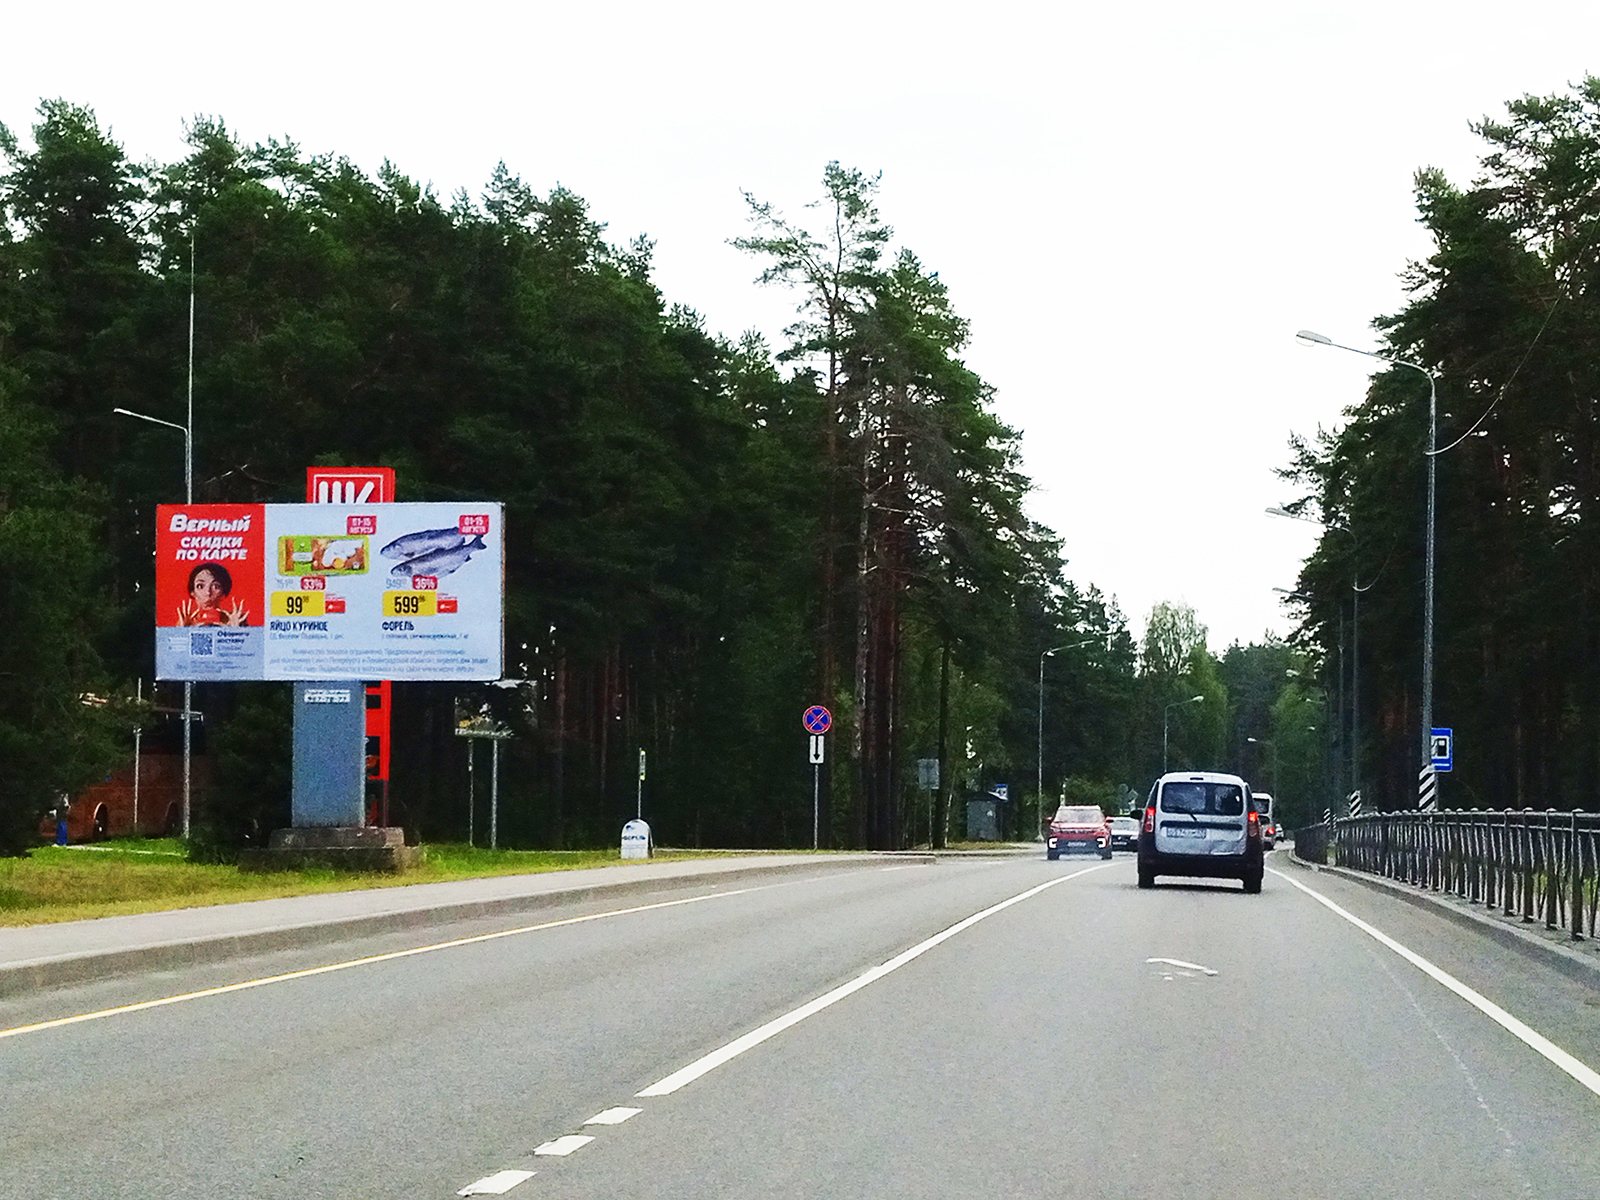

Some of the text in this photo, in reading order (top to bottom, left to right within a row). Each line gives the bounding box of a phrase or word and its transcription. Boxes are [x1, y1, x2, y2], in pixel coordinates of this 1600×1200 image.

[200, 548, 249, 561] КАРТЕ
[292, 621, 328, 632] КУРИНОЕ
[382, 621, 415, 632] ФОРЕЛЬ
